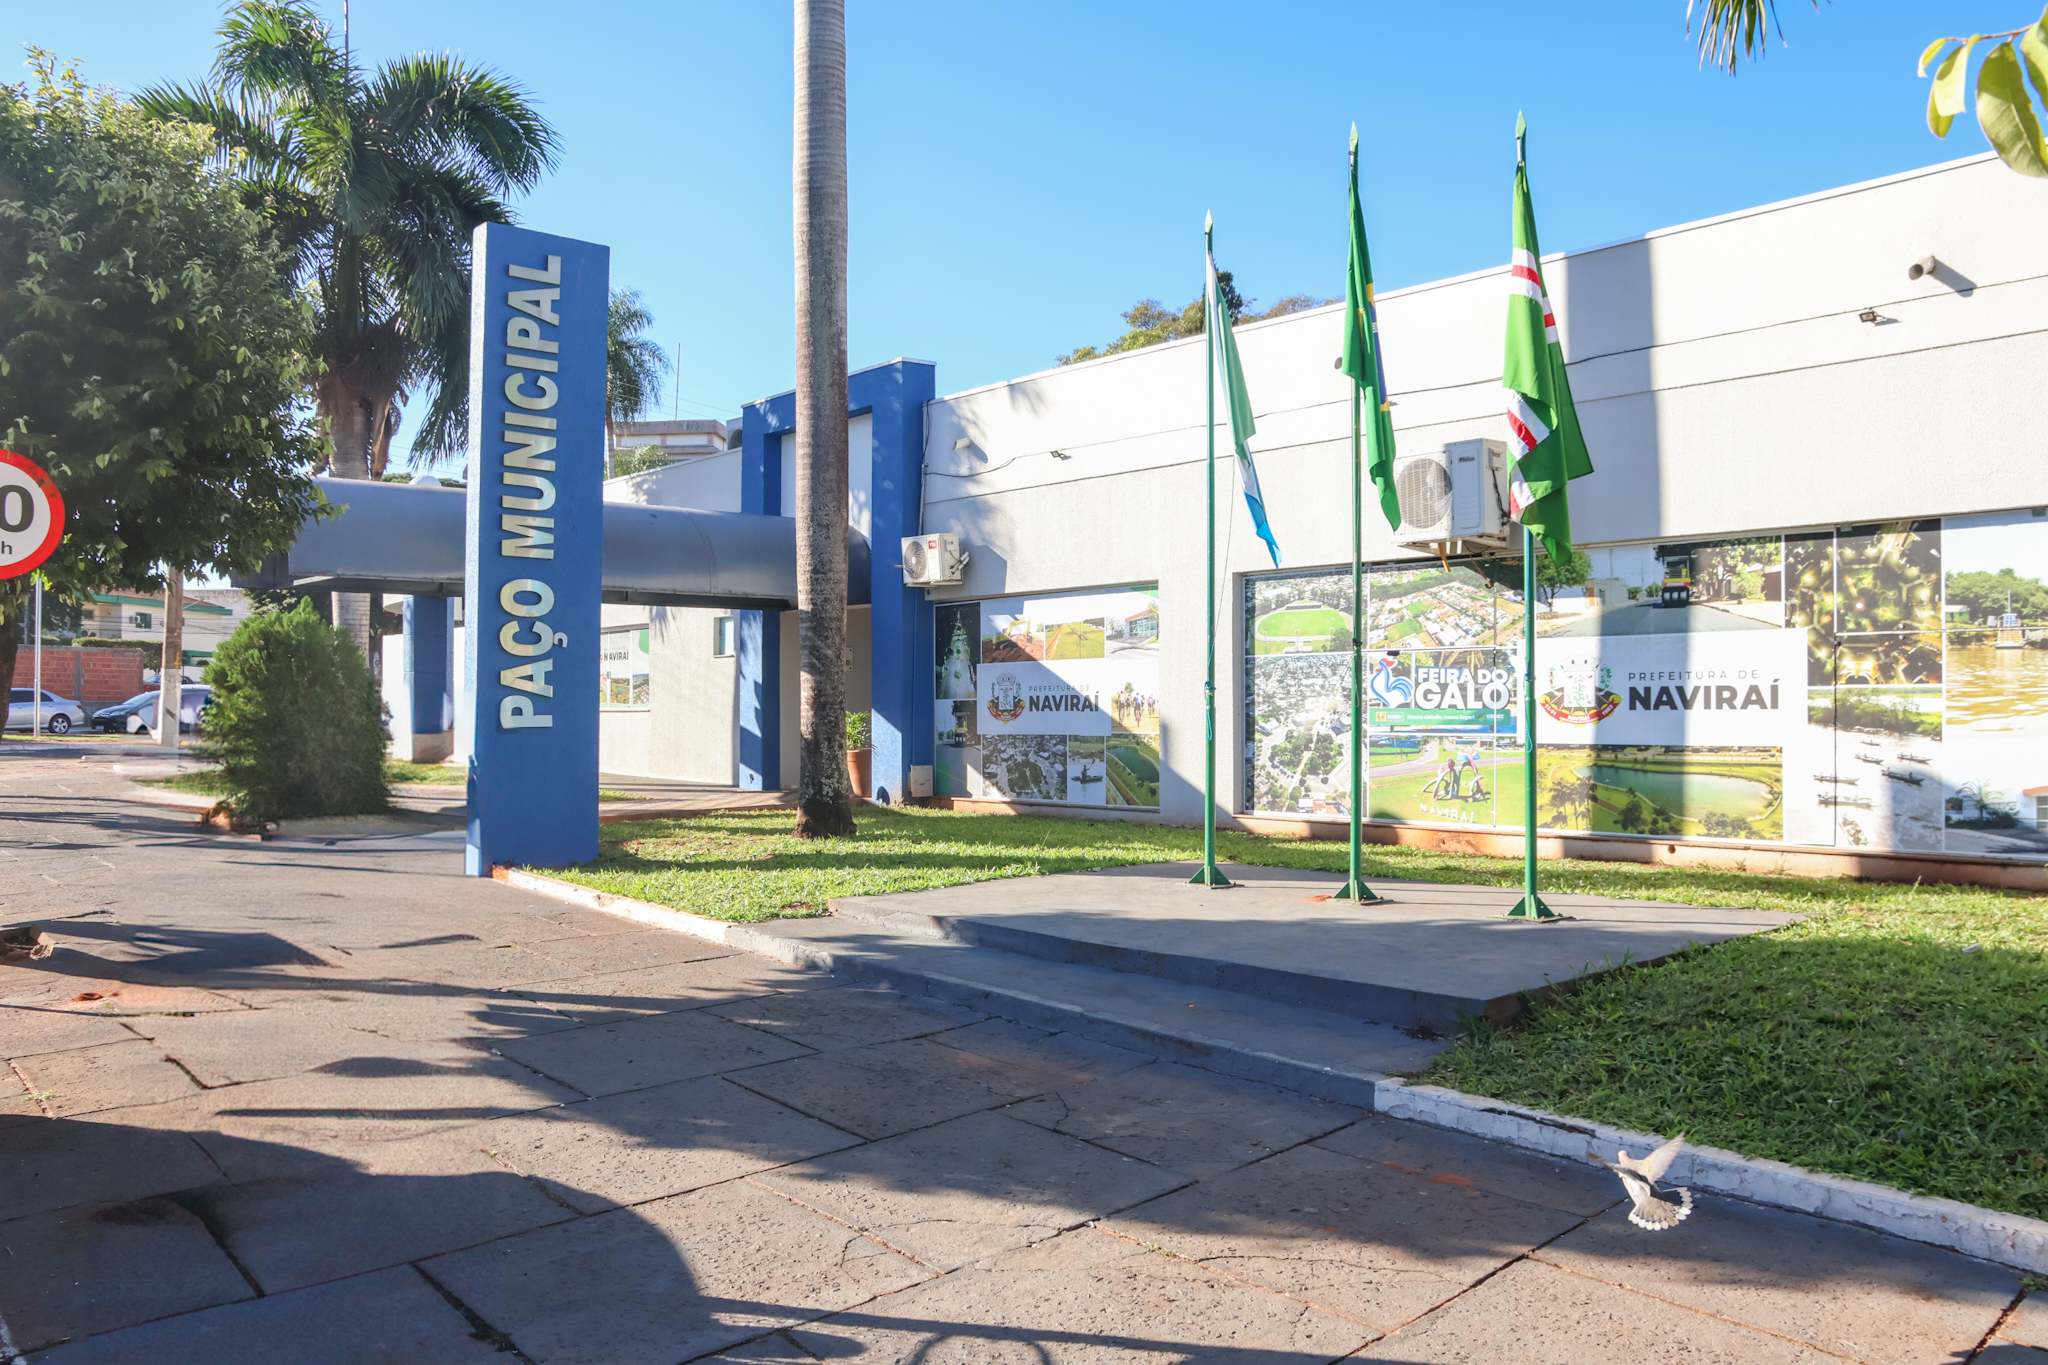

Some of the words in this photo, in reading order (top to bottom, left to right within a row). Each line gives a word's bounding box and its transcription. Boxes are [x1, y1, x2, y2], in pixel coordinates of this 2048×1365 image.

[501, 254, 562, 561] MUNICIPAL
[500, 578, 568, 729] PAÇO
[603, 649, 630, 662] NAVIRAÍ
[1417, 667, 1474, 685] FEIRA
[1477, 668, 1509, 685] DO
[1628, 670, 1728, 682] PREFEITURA
[1738, 669, 1759, 680] DE
[1028, 685, 1076, 693] PREFEITURA
[1079, 684, 1090, 692] DE
[1415, 681, 1510, 710] GALO
[1628, 679, 1781, 711] NAVIRAÍ
[1028, 691, 1100, 712] NAVIRAÍ
